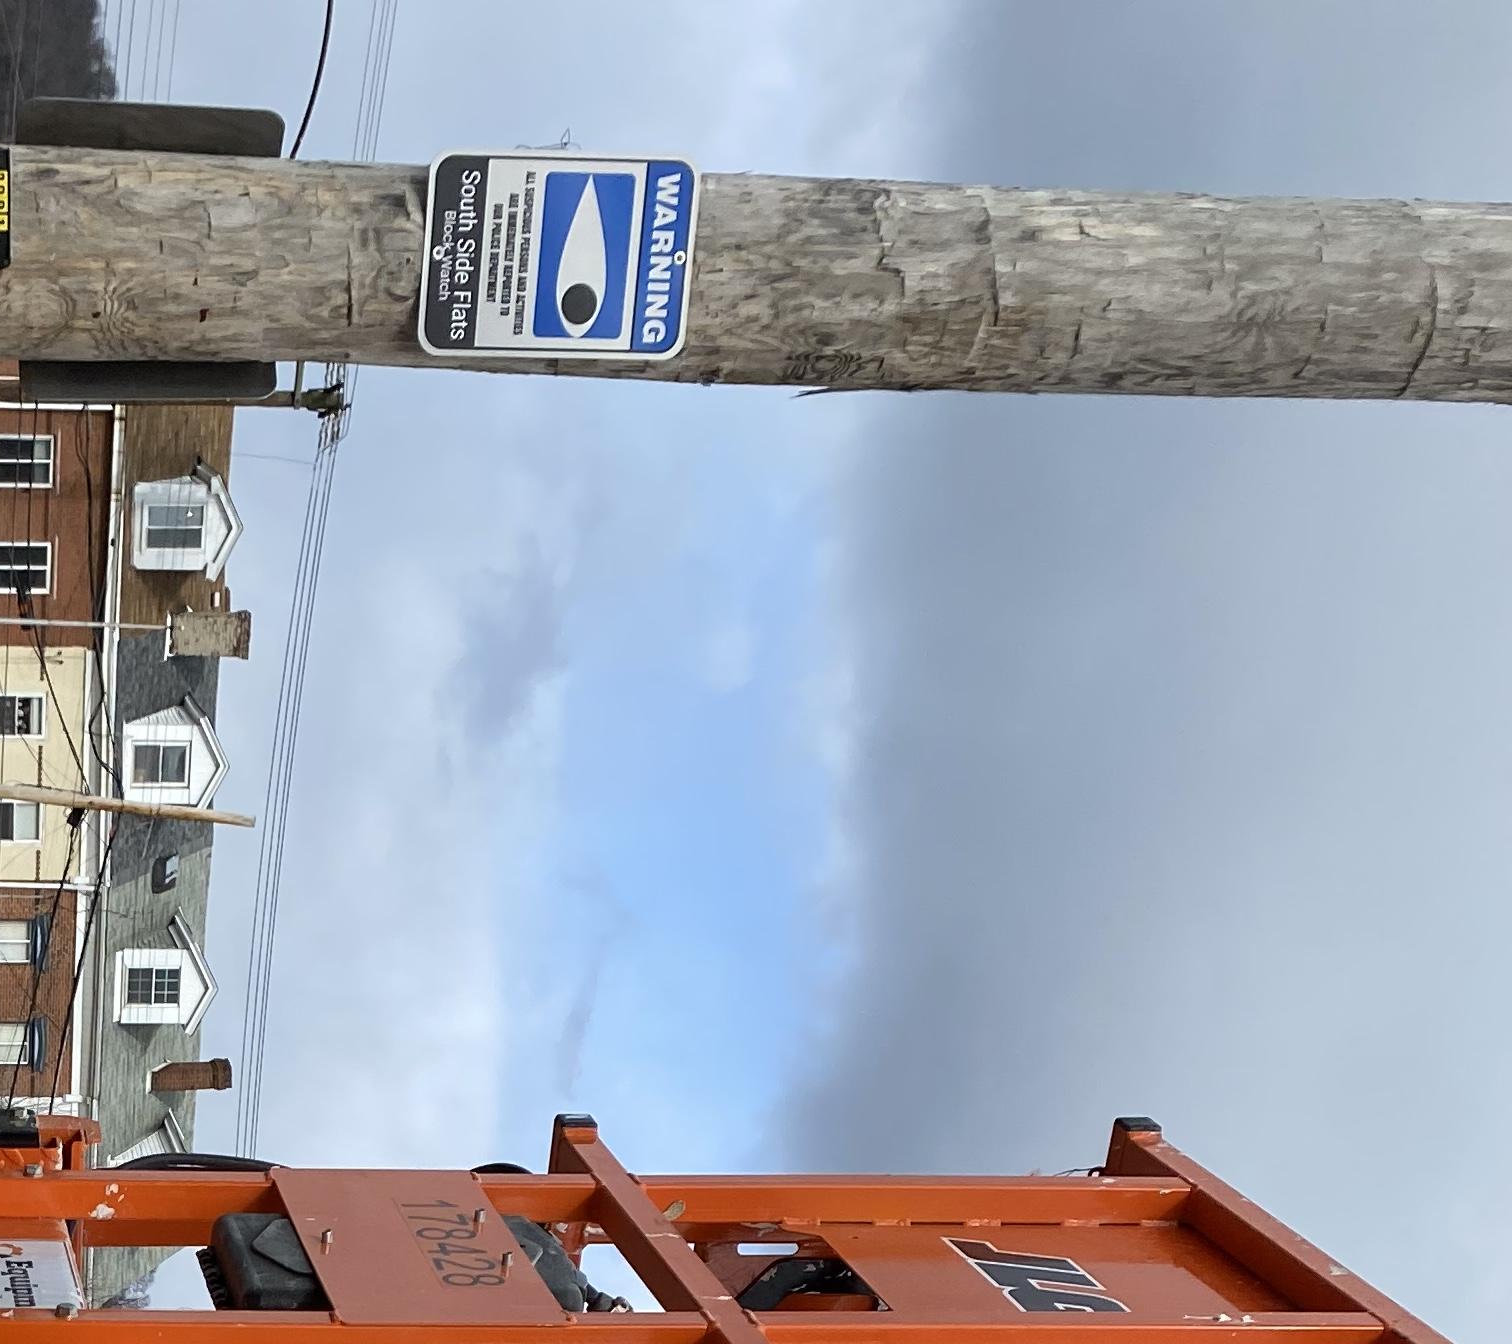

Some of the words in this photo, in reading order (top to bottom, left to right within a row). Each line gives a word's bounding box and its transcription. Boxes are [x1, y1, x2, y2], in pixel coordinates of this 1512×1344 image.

[458, 170, 481, 231] South
[526, 171, 536, 184] ALL
[442, 210, 457, 250] Block
[490, 222, 502, 250] POLICE
[438, 255, 451, 301] Watch
[454, 238, 476, 286] Side
[486, 252, 500, 302] DEPARTMENT
[519, 237, 531, 273] PERSONS
[642, 173, 681, 344] WARNING
[517, 275, 528, 291] AND
[450, 291, 471, 340] Flats
[500, 306, 510, 316] TO
[400, 1199, 506, 1287] 178428
[1, 1260, 38, 1307] Equipm
[941, 1237, 1132, 1313] JLG
